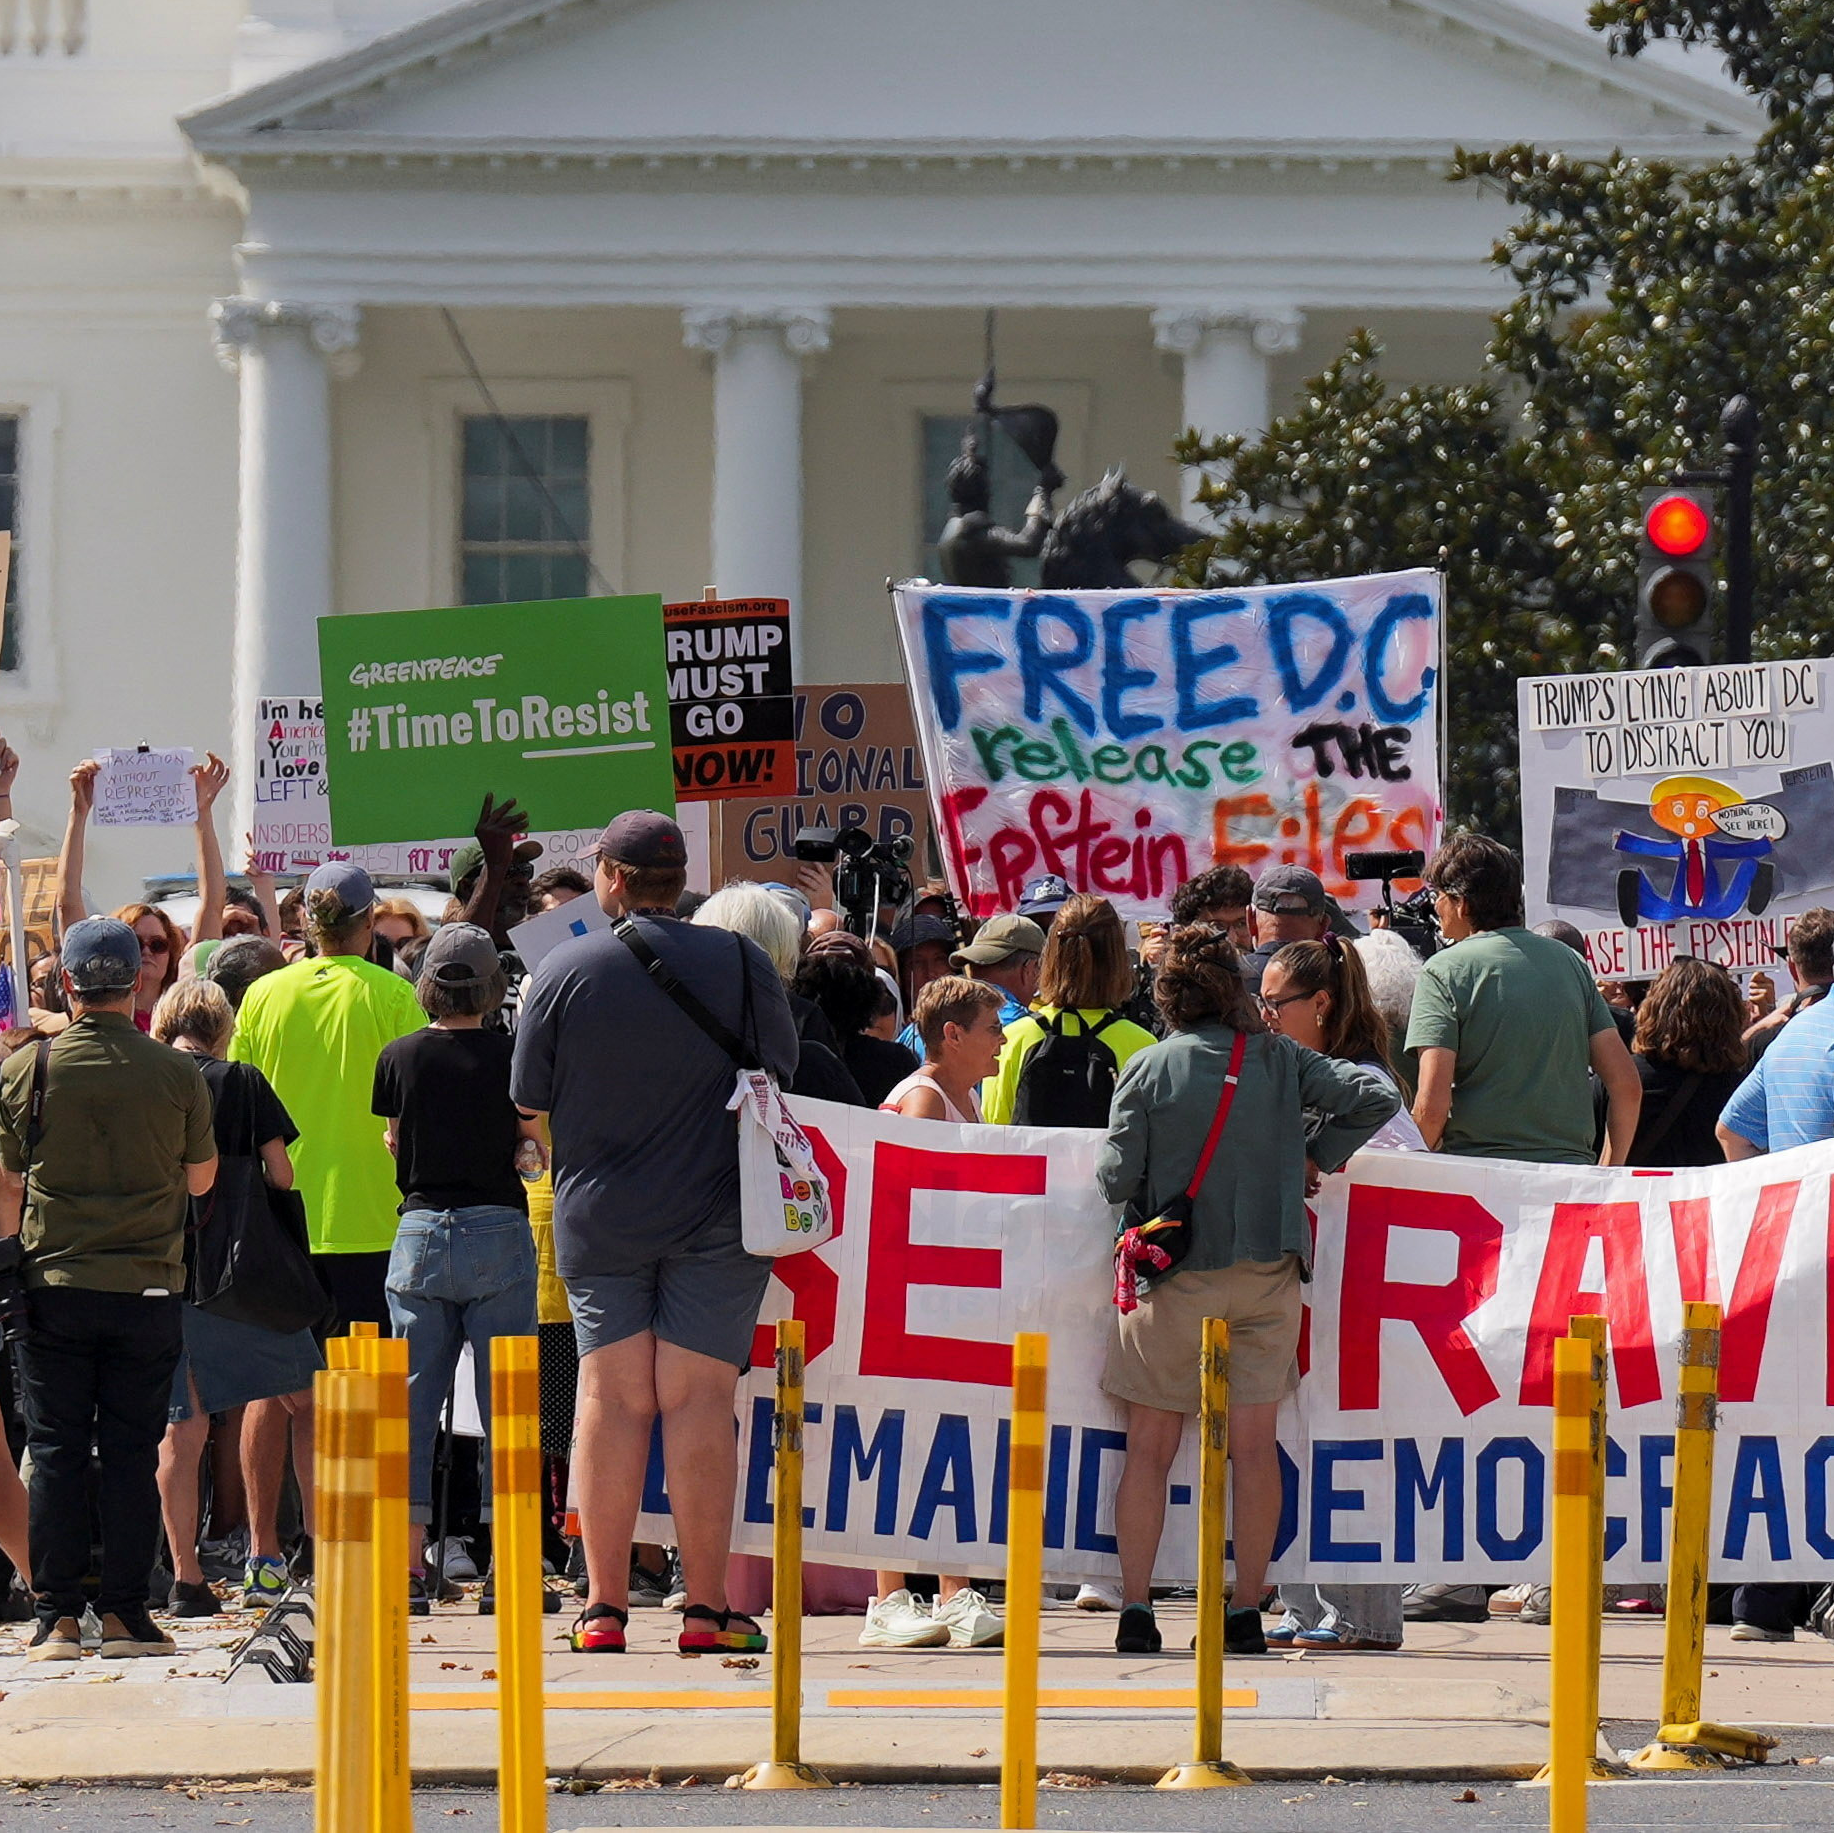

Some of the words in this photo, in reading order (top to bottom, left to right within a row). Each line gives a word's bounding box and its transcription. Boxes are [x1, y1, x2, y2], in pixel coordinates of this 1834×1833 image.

[664, 600, 777, 618] useFascism.org
[667, 625, 783, 663] RUMP
[348, 654, 504, 689] GREENPEACE
[921, 593, 1259, 740] FREE
[261, 699, 289, 721] I'm
[1532, 676, 1616, 726] TRUMP'S
[1625, 672, 1688, 724] LYING
[1704, 668, 1767, 714] ABOUT
[1782, 664, 1815, 707] DC
[347, 689, 652, 753] #TimeToResist
[685, 702, 745, 738] GO
[101, 753, 184, 769] TAXATION
[969, 716, 1264, 790] release
[1292, 722, 1413, 782] THE
[1585, 730, 1614, 774] TO
[1623, 722, 1726, 771] DISTRACT
[1740, 718, 1787, 760] YOU
[105, 770, 161, 785] WITHOUT
[276, 760, 320, 778] love
[672, 748, 776, 788] NOW!
[795, 746, 925, 797] IONAL
[1783, 766, 1829, 787] EPSTEIN
[149, 796, 186, 810] ATION
[256, 778, 314, 803] LEFT
[1725, 819, 1742, 831] SEE
[1759, 806, 1771, 816] TO
[253, 822, 330, 845] INSIDERS
[1637, 924, 1676, 971] THE
